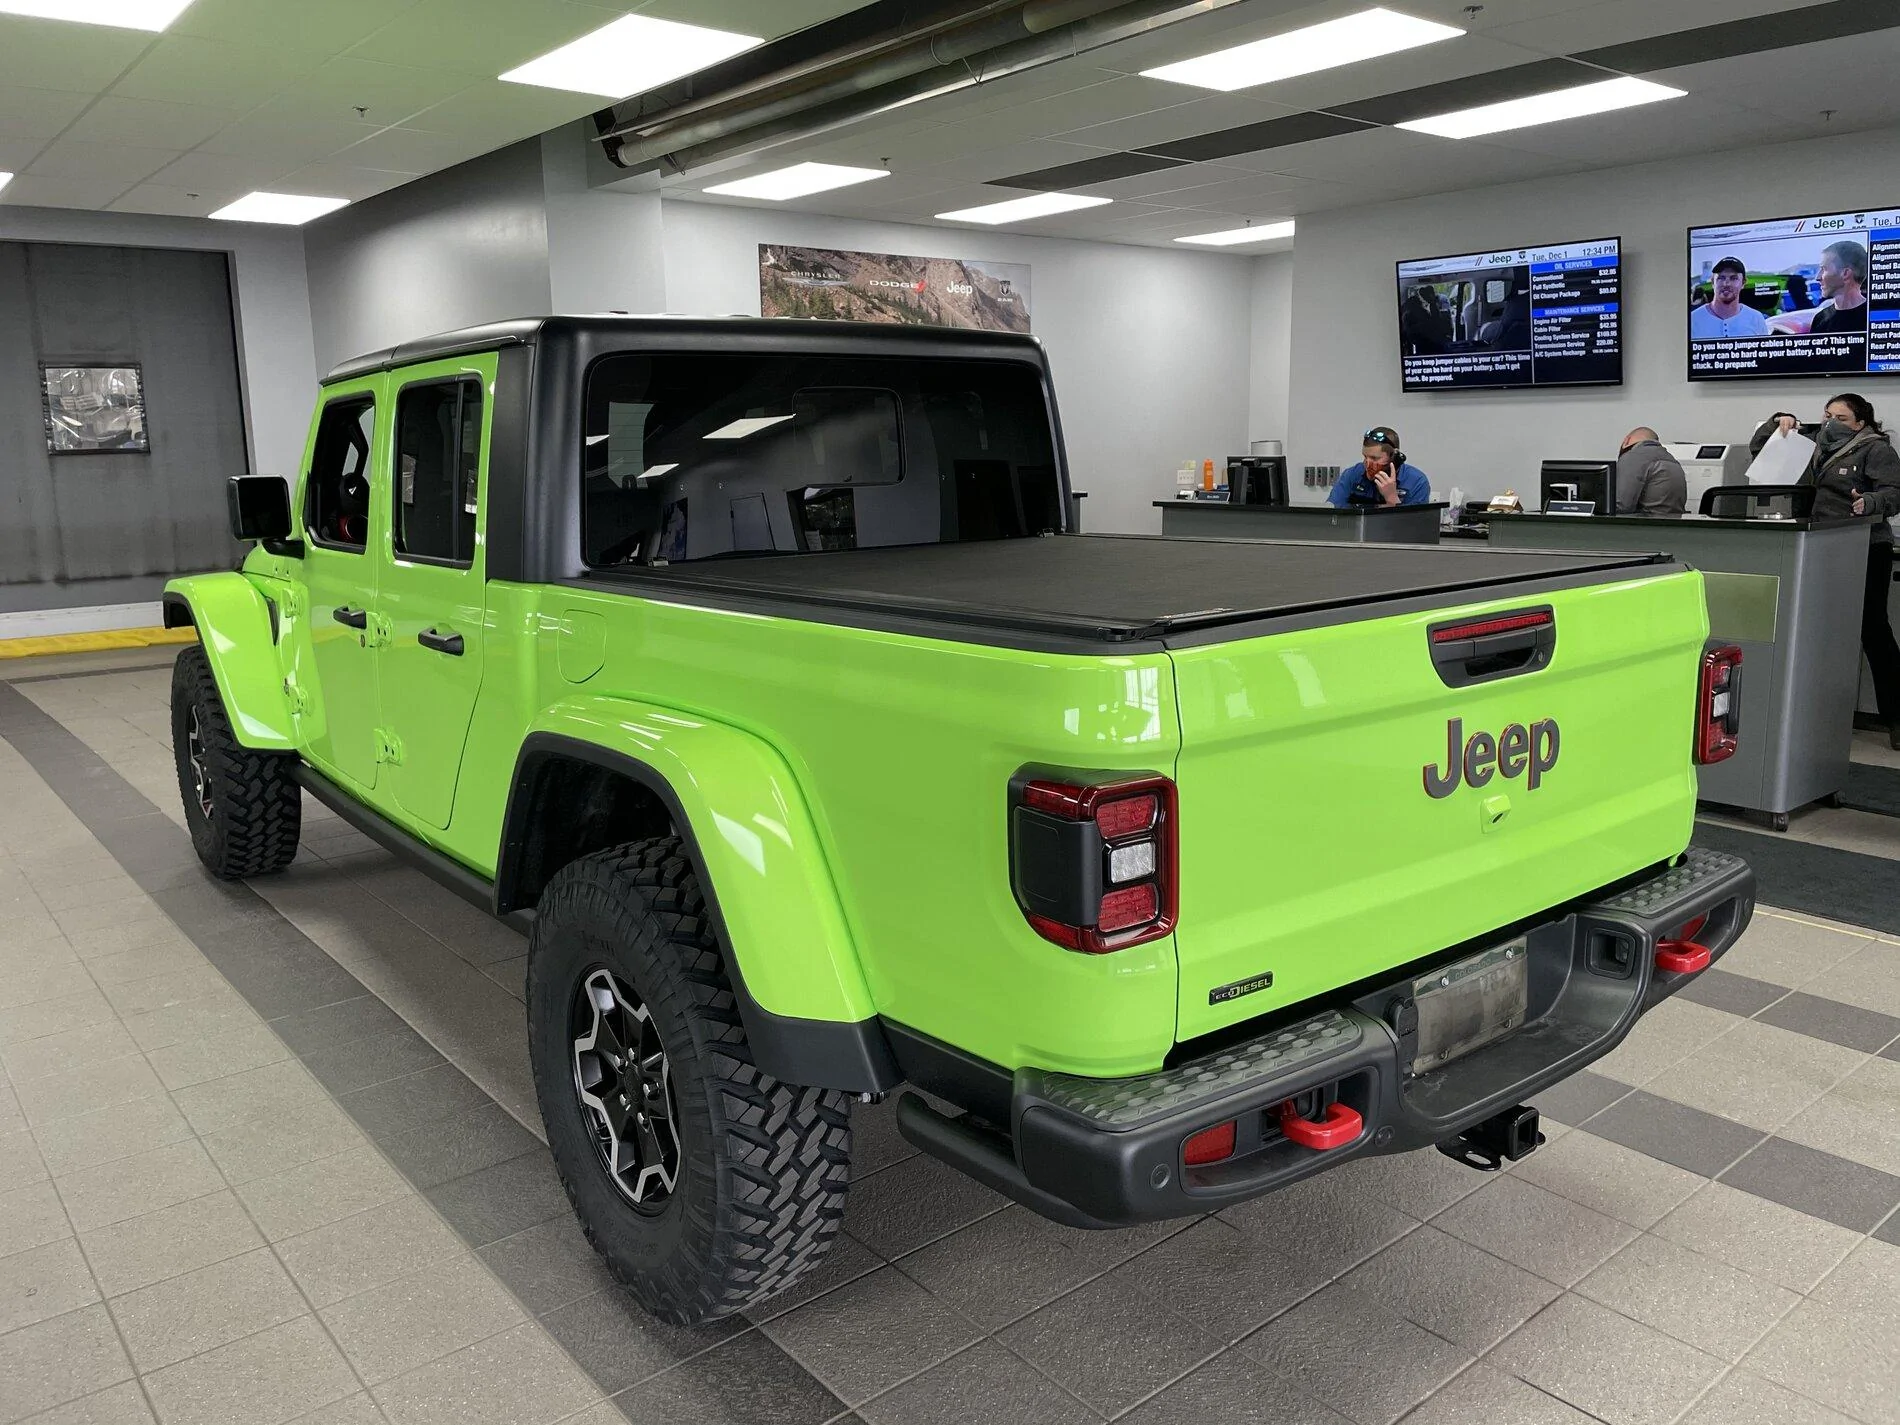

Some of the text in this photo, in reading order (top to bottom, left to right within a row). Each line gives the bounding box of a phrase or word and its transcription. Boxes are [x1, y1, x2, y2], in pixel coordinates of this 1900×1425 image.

[1814, 218, 1844, 230] Jeep
[1872, 217, 1892, 226] Tue,
[1582, 246, 1616, 256] 12:34 PM
[1488, 254, 1512, 264] Jeep
[1532, 254, 1547, 262] Tue,
[1548, 252, 1562, 260] Dec
[1565, 260, 1593, 269] SERVICES
[1872, 262, 1892, 270] Wheel
[790, 270, 840, 278] CHRYSLER
[946, 280, 972, 296] Jeep
[1580, 305, 1605, 314] SERVICES
[1871, 322, 1890, 330] Brake
[1692, 344, 1702, 352] Do
[1703, 344, 1716, 352] you
[1716, 342, 1734, 350] keep
[1734, 341, 1760, 350] jumper
[1760, 340, 1784, 348] cables
[1794, 340, 1810, 348] your
[1812, 338, 1828, 346] car?
[1830, 336, 1846, 345] This
[1847, 336, 1864, 344] time
[1692, 352, 1700, 360] of
[1701, 353, 1716, 362] year
[1730, 350, 1740, 358] be
[1740, 350, 1757, 358] hard
[1768, 350, 1786, 358] your
[1786, 348, 1814, 357] battery.
[1816, 346, 1836, 355] Don't
[1838, 346, 1850, 356] get
[1436, 358, 1454, 366] jumper
[1692, 362, 1714, 370] stuck.
[1724, 360, 1758, 370] prepared.
[1423, 717, 1561, 799] Jeep
